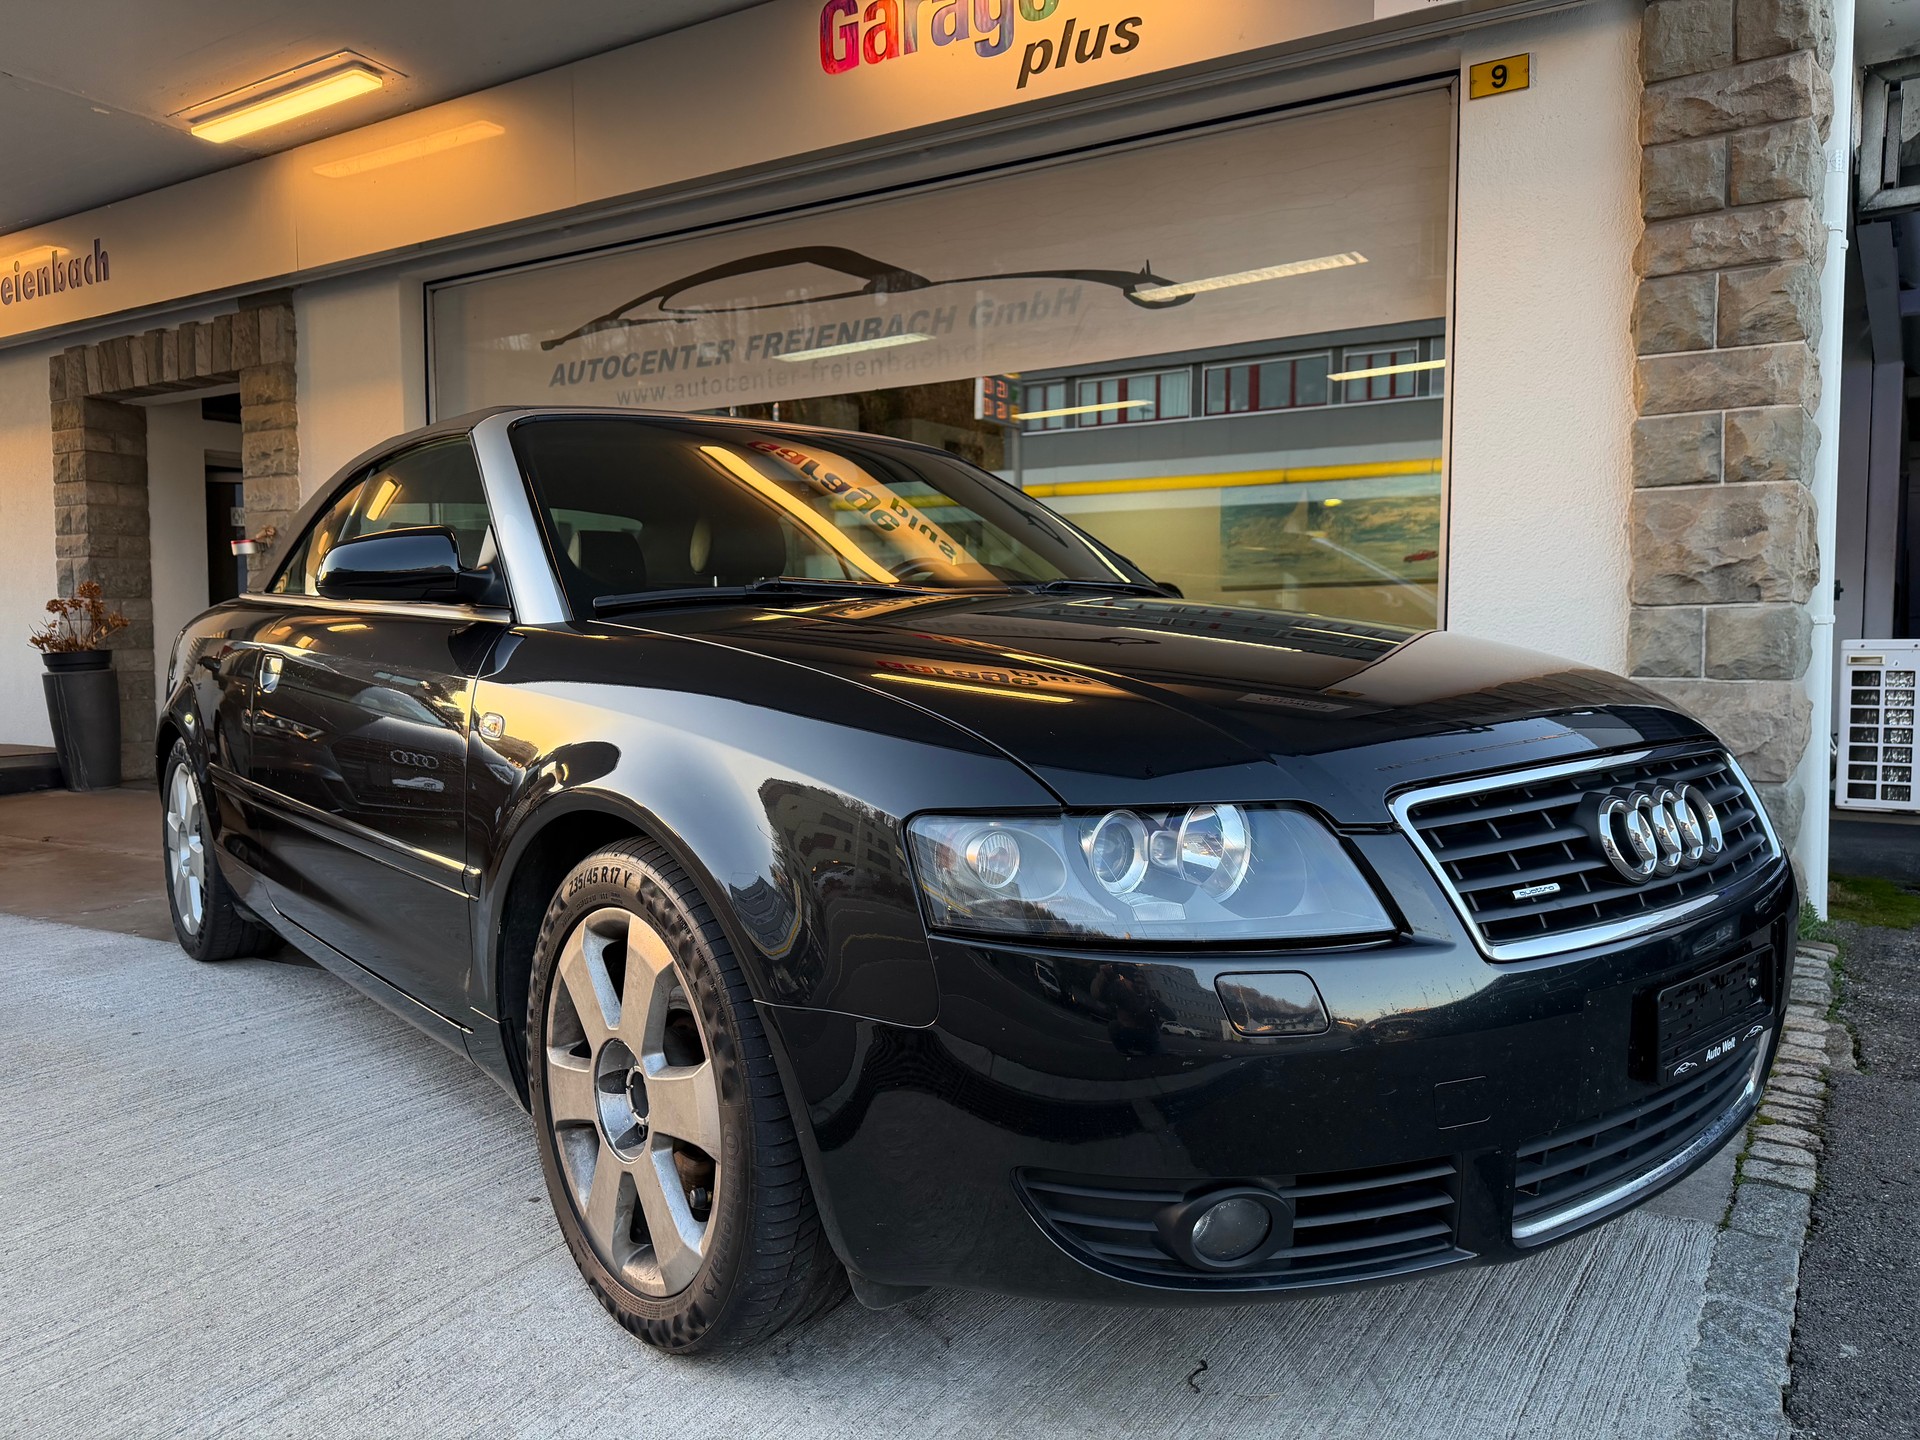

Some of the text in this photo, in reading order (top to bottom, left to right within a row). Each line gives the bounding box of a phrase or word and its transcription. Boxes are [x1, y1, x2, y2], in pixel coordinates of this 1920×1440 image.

[1016, 16, 1143, 90] plus
[1491, 64, 1508, 89] 9
[0, 238, 110, 306] eienbach
[549, 284, 1083, 388] AUTOCENTER FREIENBACH GmbH
[568, 866, 599, 898] 235/45
[623, 870, 634, 889] Y
[1519, 885, 1555, 898] quattro
[1705, 1036, 1736, 1062] Auto Welt
